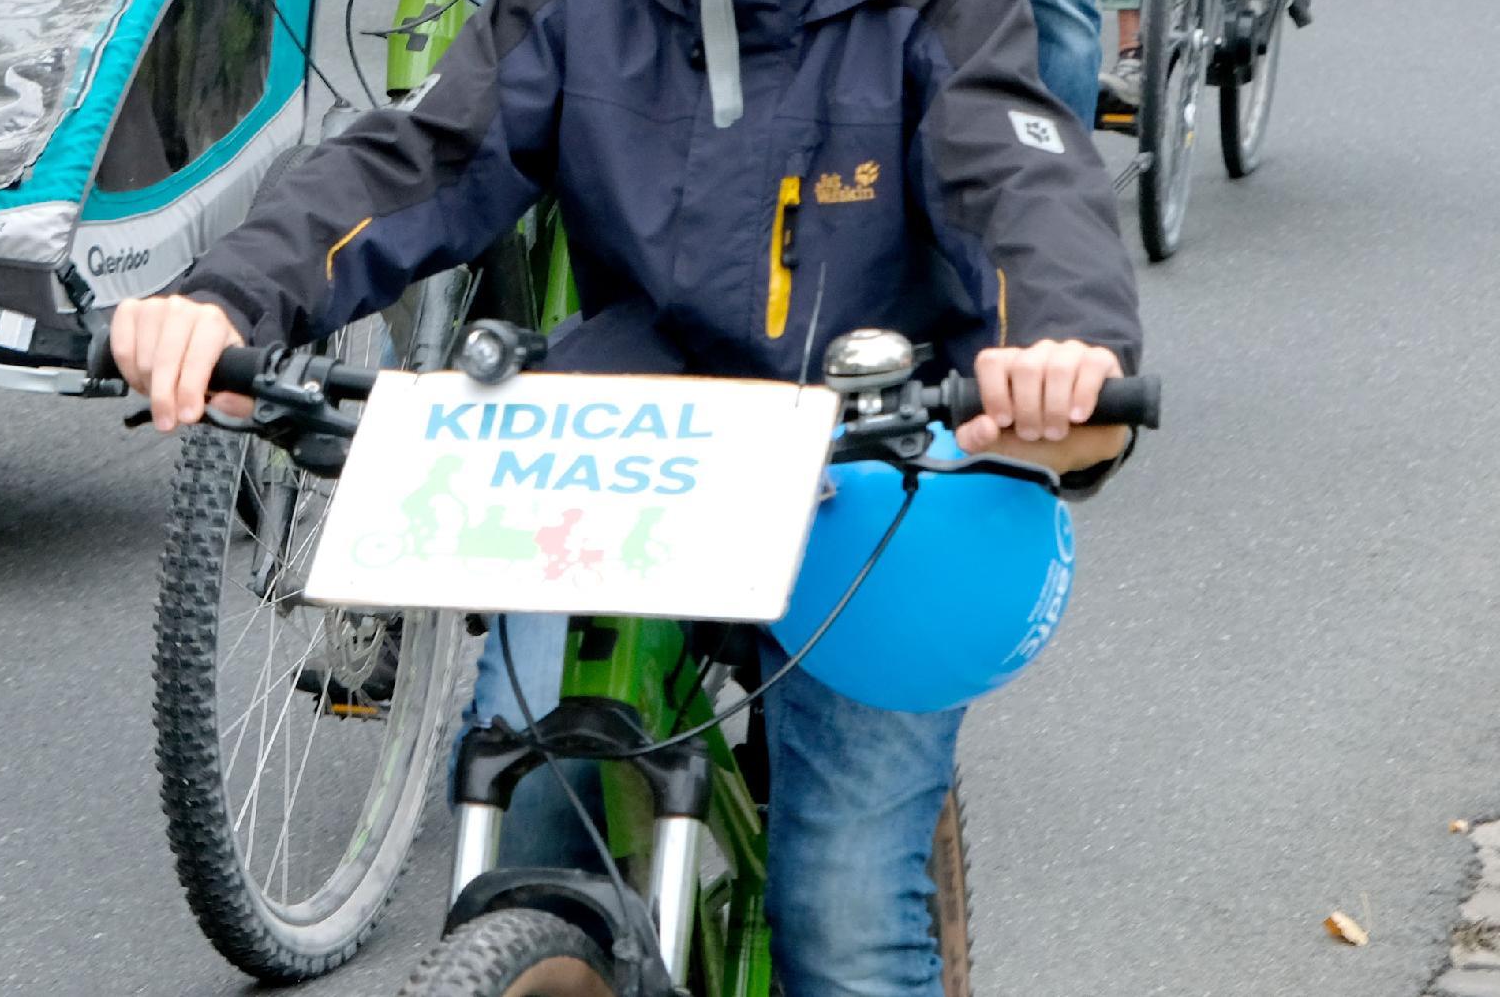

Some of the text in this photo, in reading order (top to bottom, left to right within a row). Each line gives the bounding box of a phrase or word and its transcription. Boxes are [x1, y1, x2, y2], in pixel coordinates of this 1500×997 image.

[87, 245, 150, 277] Qeridoo
[424, 403, 714, 440] KIDICAL
[490, 451, 700, 495] MASS
